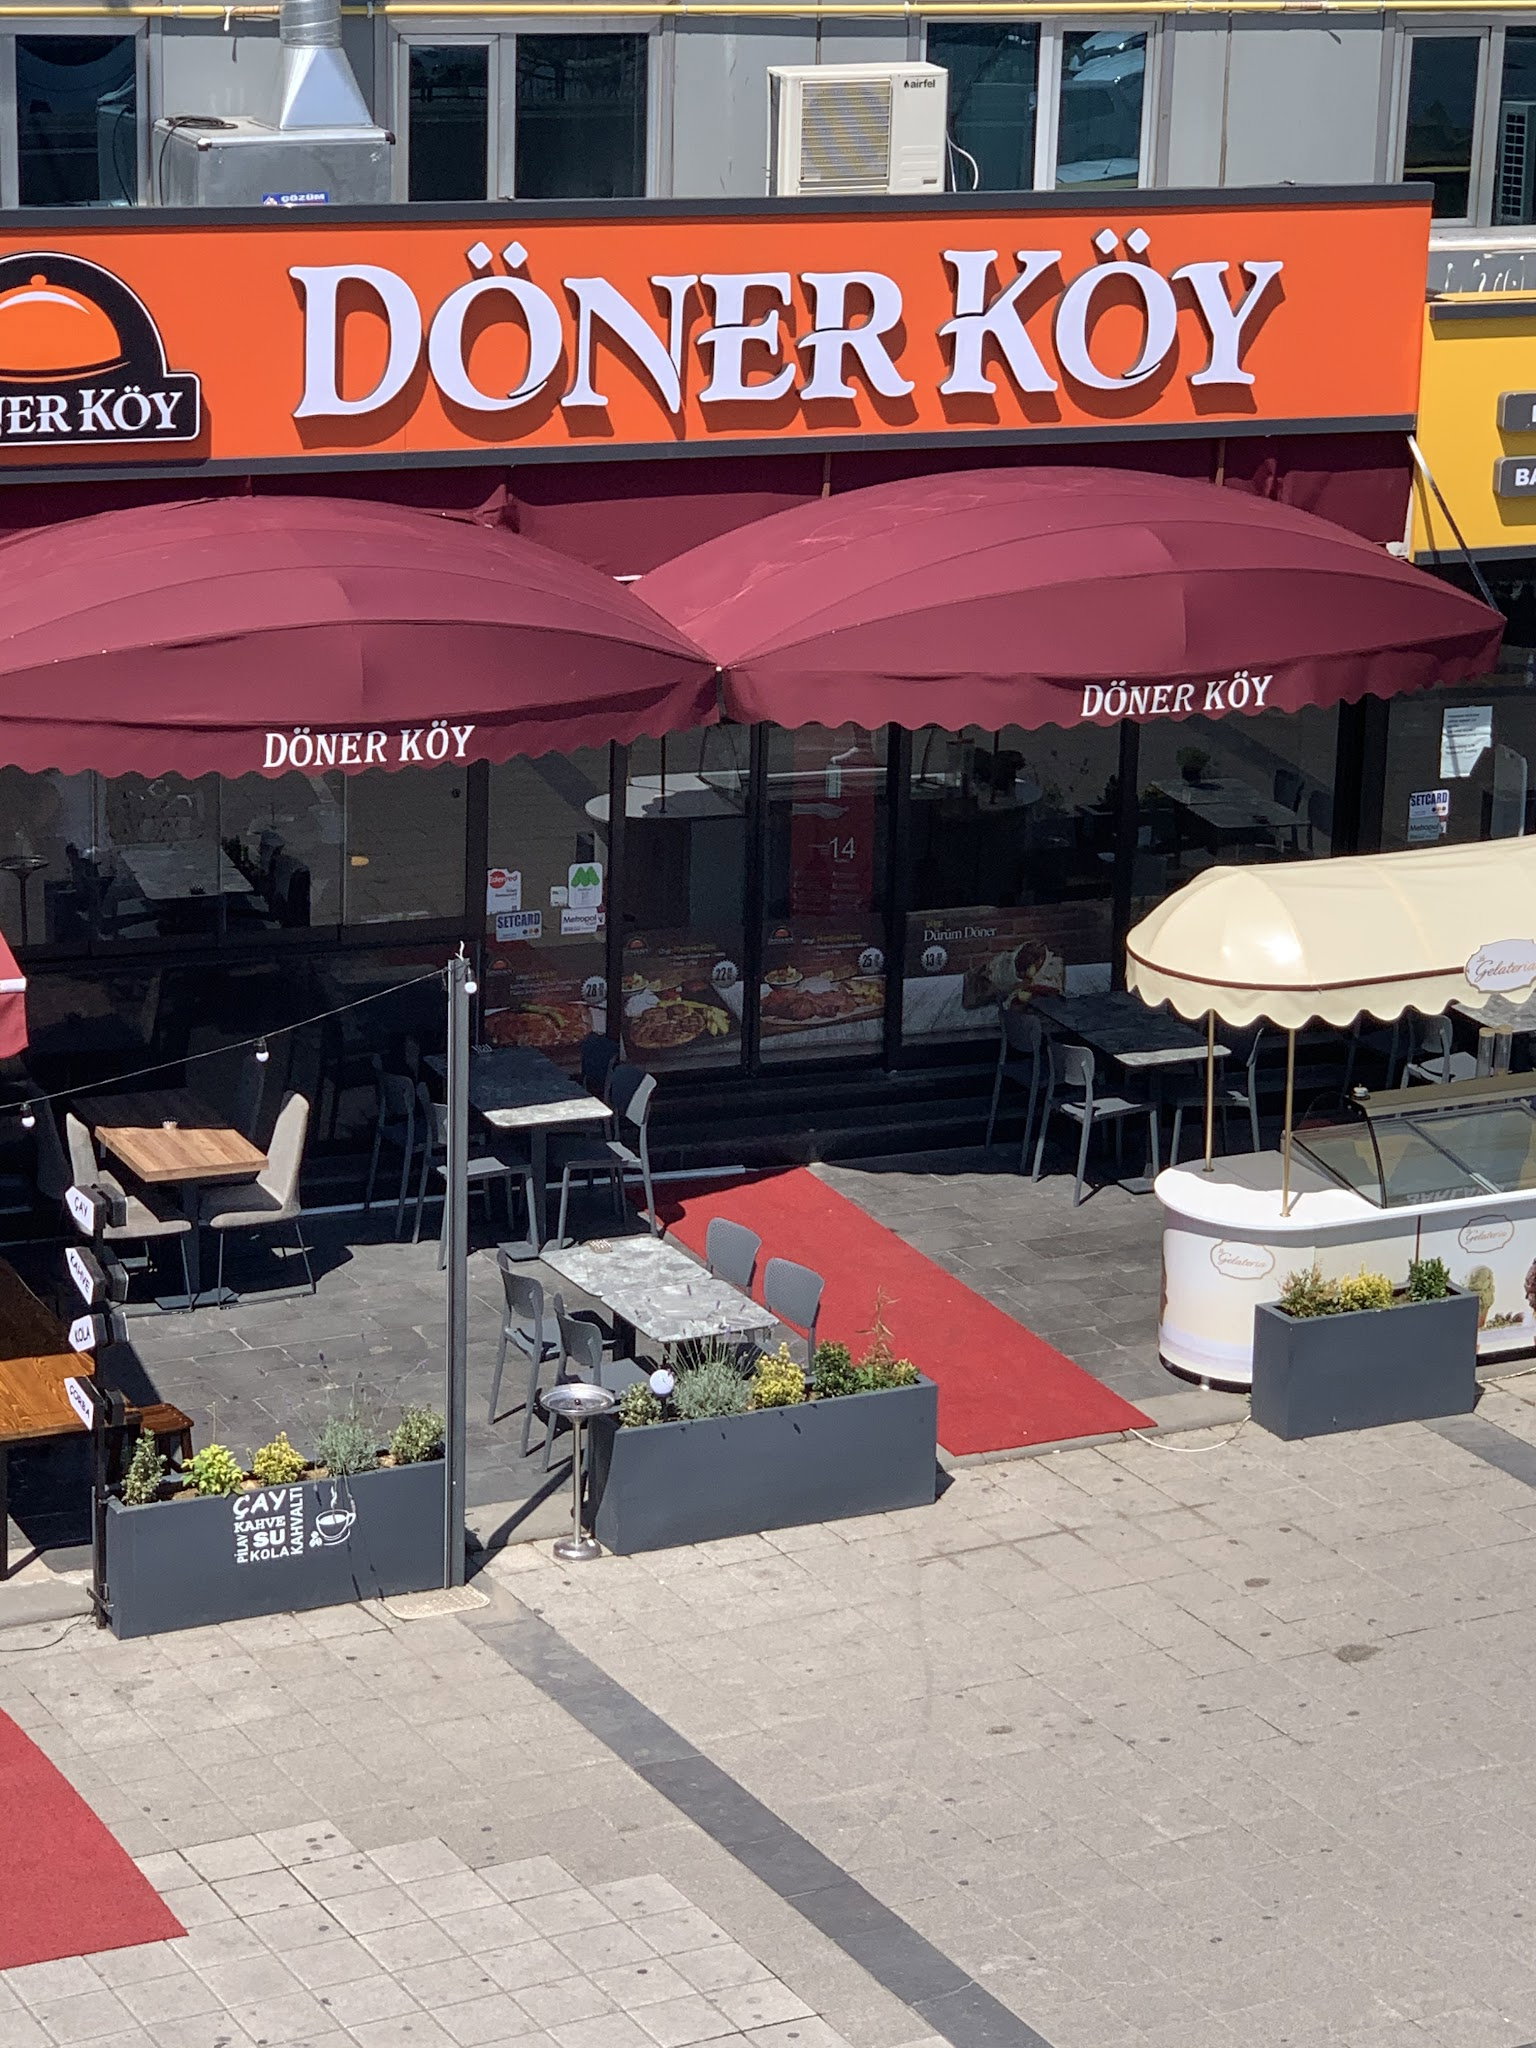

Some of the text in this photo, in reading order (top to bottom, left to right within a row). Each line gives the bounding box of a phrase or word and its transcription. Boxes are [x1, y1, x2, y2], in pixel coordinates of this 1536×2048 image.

[910, 79, 936, 88] airfel
[288, 228, 1284, 418] DÖNER KÖY
[0, 385, 183, 436] ER KÖY
[1080, 671, 1274, 718] DÖNER KÖY
[262, 720, 476, 769] DÖNER KÖY
[1410, 792, 1448, 807] SETCARD
[830, 837, 857, 859] 14
[497, 912, 540, 929] SETCARD
[924, 926, 997, 941] Dürüm Döner
[862, 953, 872, 967] 25
[586, 983, 597, 997] 28
[74, 1196, 88, 1217] ÇAY
[69, 1253, 91, 1294] KAHVE
[74, 1330, 92, 1343] KOLA
[232, 1489, 287, 1520] ÇAY
[233, 1515, 286, 1533] KAHVE
[290, 1487, 304, 1555] KAHVALTI
[252, 1529, 286, 1548] SU
[249, 1545, 290, 1562] KOLA
